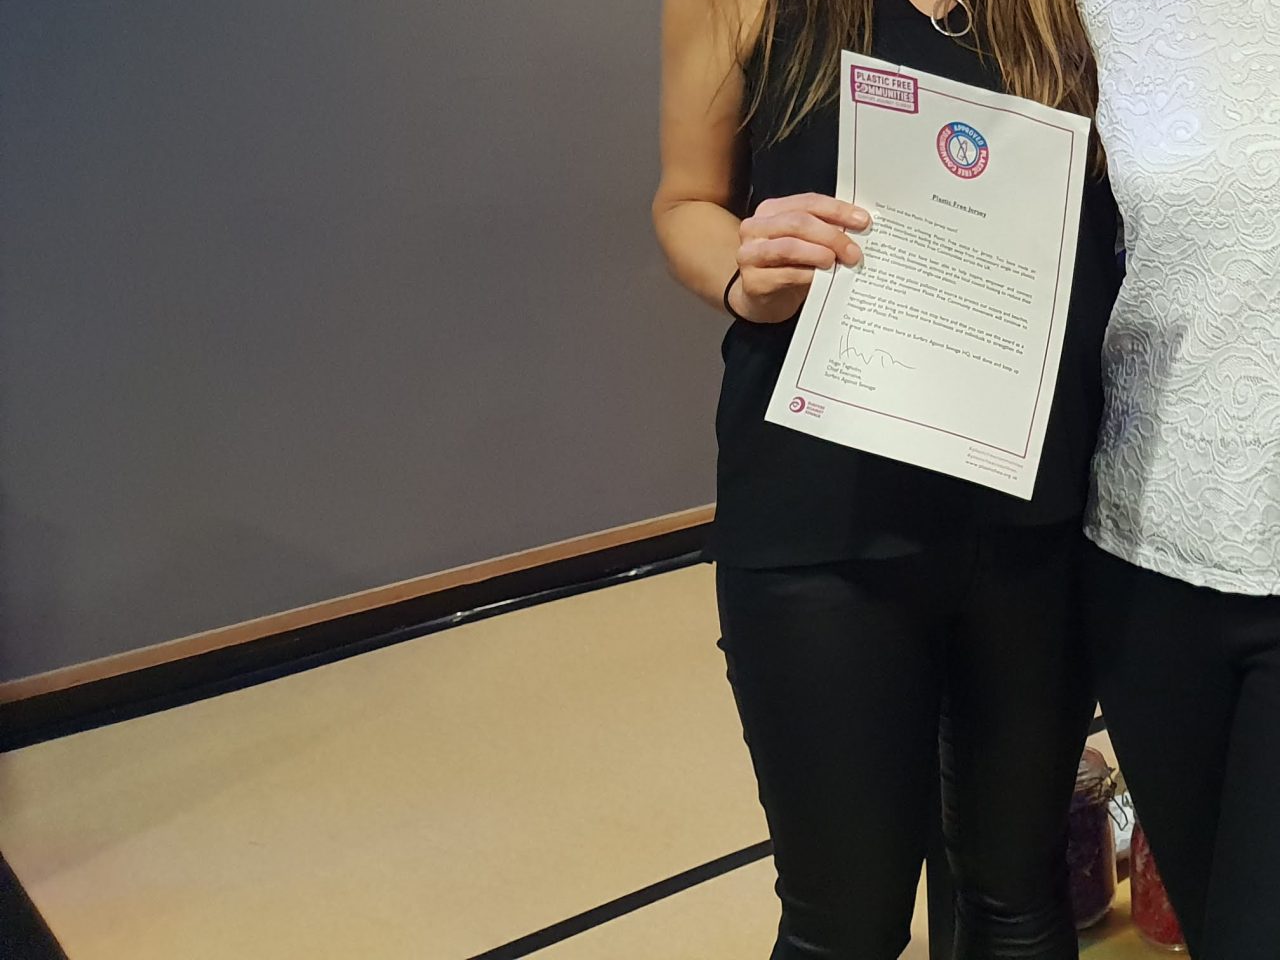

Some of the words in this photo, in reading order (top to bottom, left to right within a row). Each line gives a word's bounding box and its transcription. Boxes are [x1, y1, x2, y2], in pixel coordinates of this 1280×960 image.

[856, 71, 890, 86] PLASTIC
[892, 79, 912, 90] FREE
[855, 82, 914, 103] COMMUNITIES
[932, 194, 951, 205] Plastic
[952, 201, 967, 210] Free
[968, 206, 986, 217] Jersey
